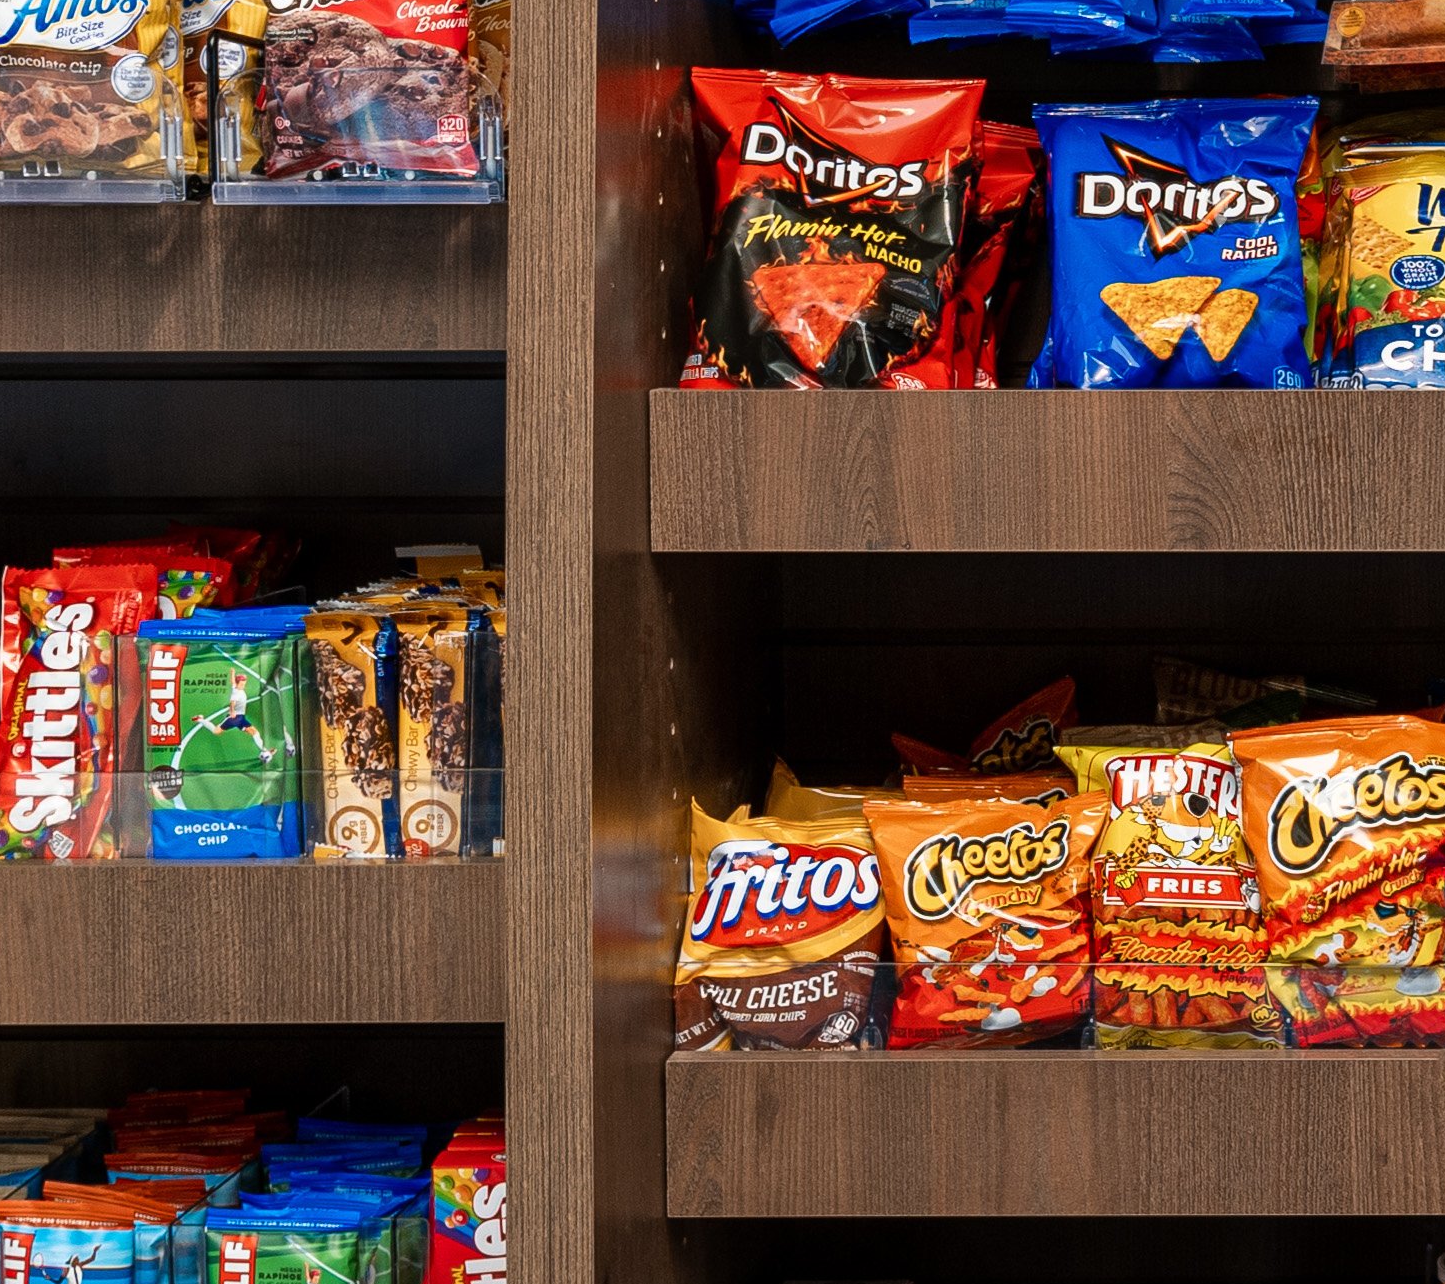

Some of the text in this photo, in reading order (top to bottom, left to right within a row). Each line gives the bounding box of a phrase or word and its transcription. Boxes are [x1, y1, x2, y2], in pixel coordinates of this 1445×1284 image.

[55, 21, 105, 41] Bite Size
[69, 30, 105, 46] Cookies
[744, 123, 927, 200] Doritos
[1235, 233, 1277, 250] COOL
[866, 242, 922, 275] NACHO
[1221, 246, 1278, 262] RANCH
[151, 651, 181, 720] CLIF
[8, 602, 95, 833] Skittles
[198, 834, 228, 847] CHIP
[904, 821, 1071, 920] Cheetos
[690, 842, 881, 944] Fritos
[1146, 877, 1223, 896] FRIES
[744, 920, 809, 939] BRAND
[756, 971, 838, 1010] CHEESE
[259, 1272, 301, 1282] RAPINOE
